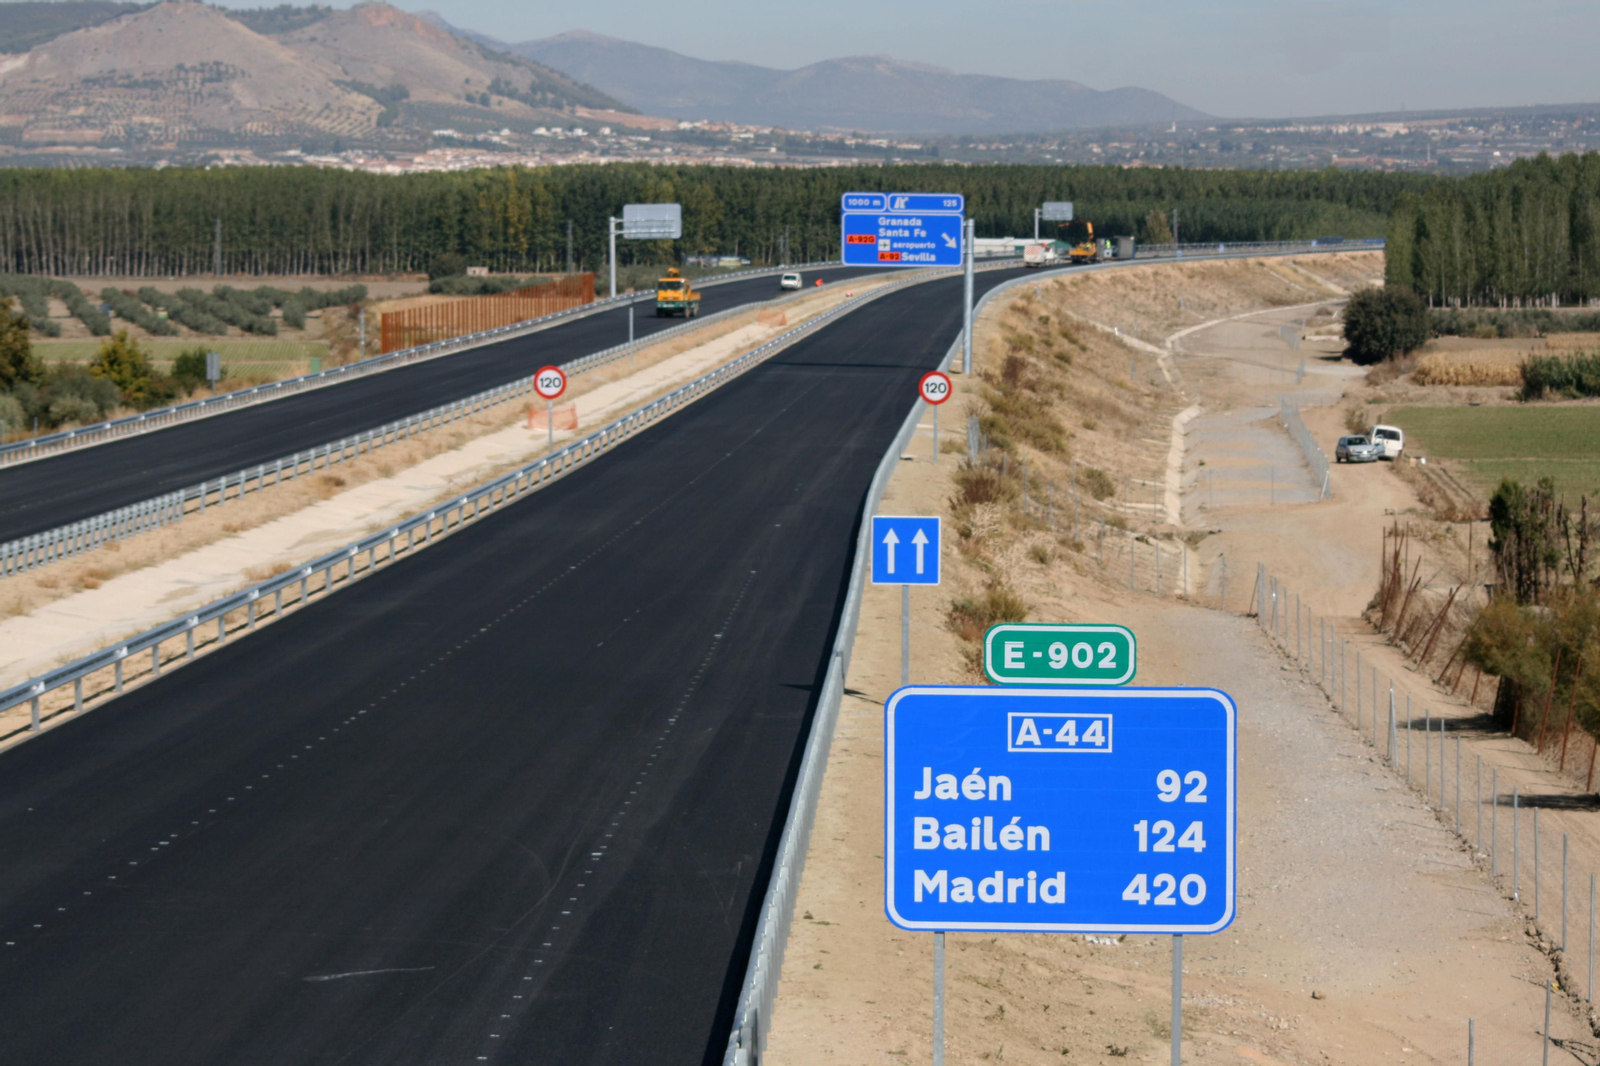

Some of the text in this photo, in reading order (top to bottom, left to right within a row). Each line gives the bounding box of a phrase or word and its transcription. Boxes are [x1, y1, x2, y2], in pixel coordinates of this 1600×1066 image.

[848, 198, 869, 206] 1000
[943, 199, 958, 207] 125
[878, 217, 922, 226] Granada
[878, 228, 927, 237] Santa Fe
[848, 235, 875, 243] A-92G
[901, 252, 936, 262] Sevilla
[540, 377, 561, 388] 120
[925, 382, 947, 393] 120
[1004, 641, 1117, 669] E-902
[1015, 718, 1106, 747] A-44
[913, 766, 1208, 803] Jaén 92
[913, 816, 1207, 853] Bailén 124
[913, 869, 1207, 906] Madrid 420
